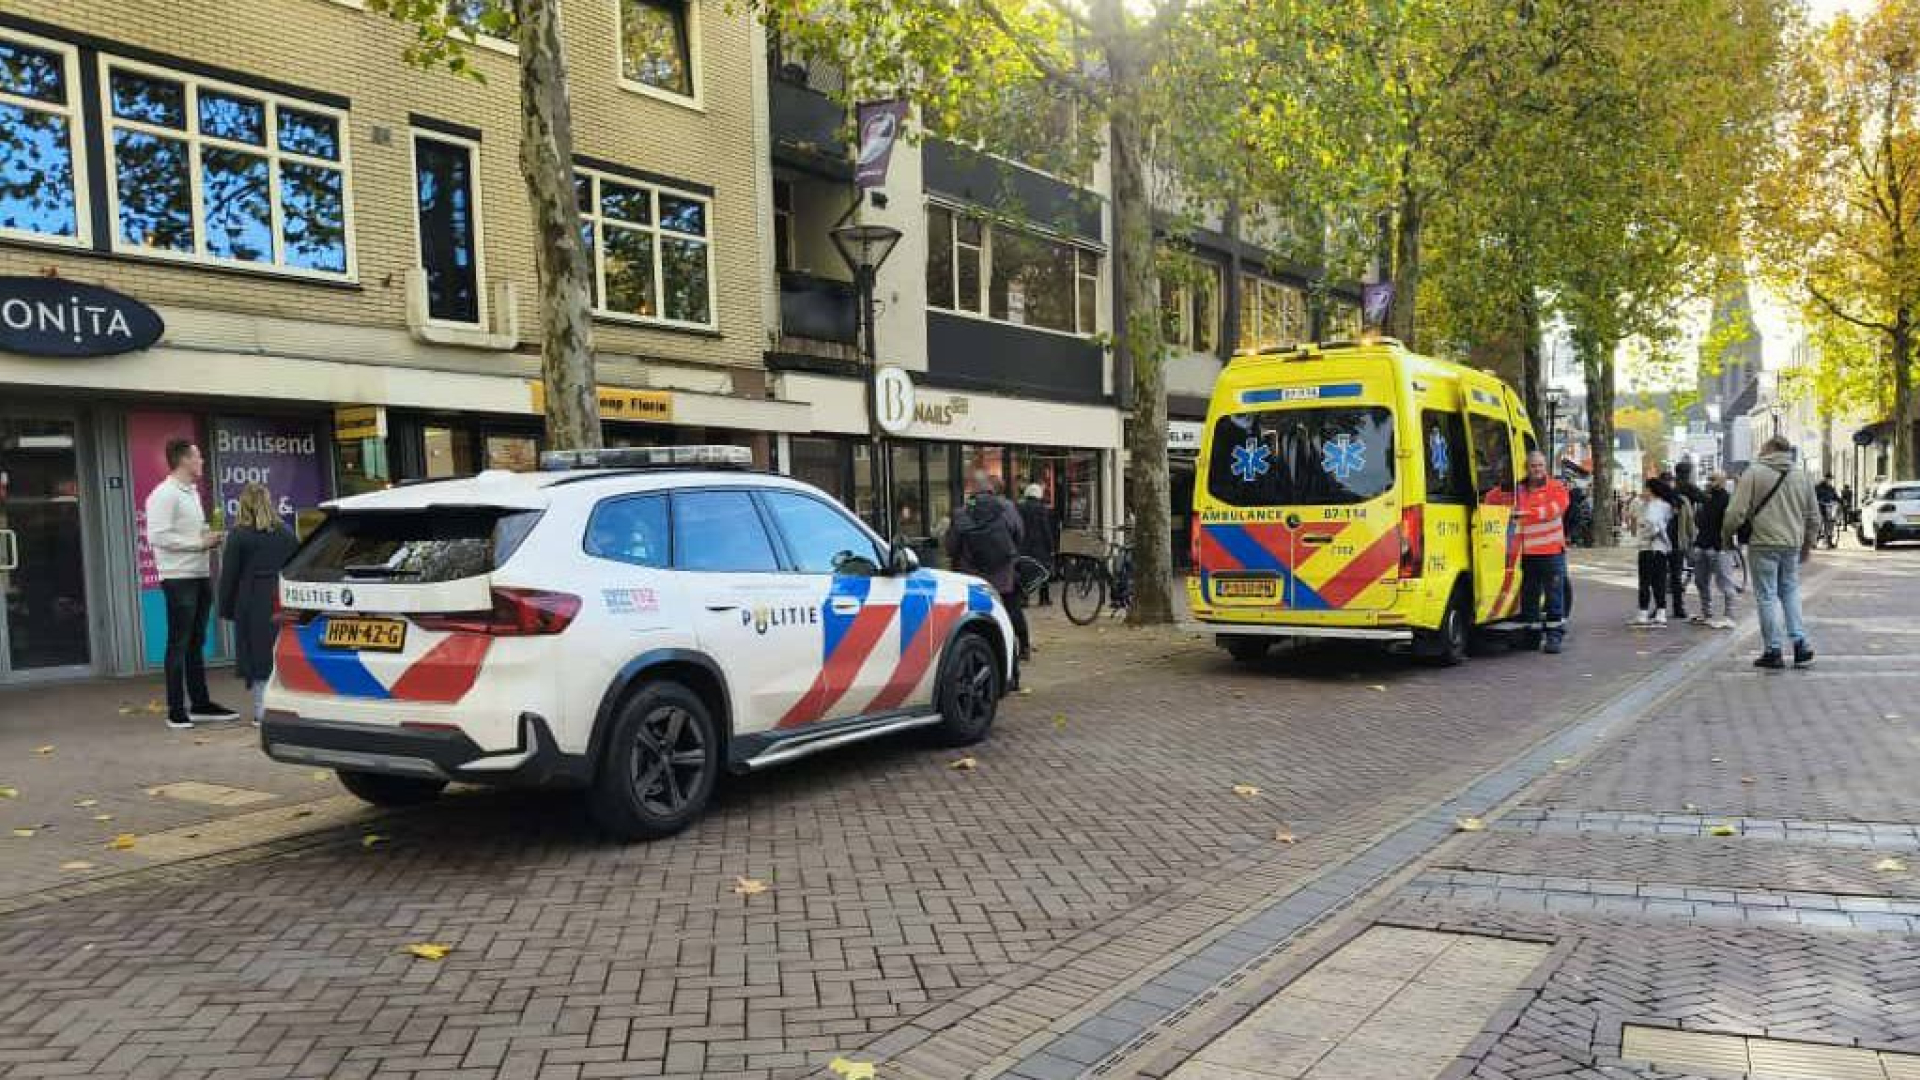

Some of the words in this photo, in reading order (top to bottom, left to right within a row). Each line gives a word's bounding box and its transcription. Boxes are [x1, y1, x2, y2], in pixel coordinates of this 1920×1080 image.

[913, 401, 952, 425] NAILS
[218, 430, 315, 453] Bruisend
[1201, 509, 1283, 521] AMBULANCE
[1324, 508, 1367, 520] 07-114
[285, 587, 336, 603] POLITIE
[742, 605, 818, 635] POLITIE
[328, 623, 400, 643] HPN-42-G
